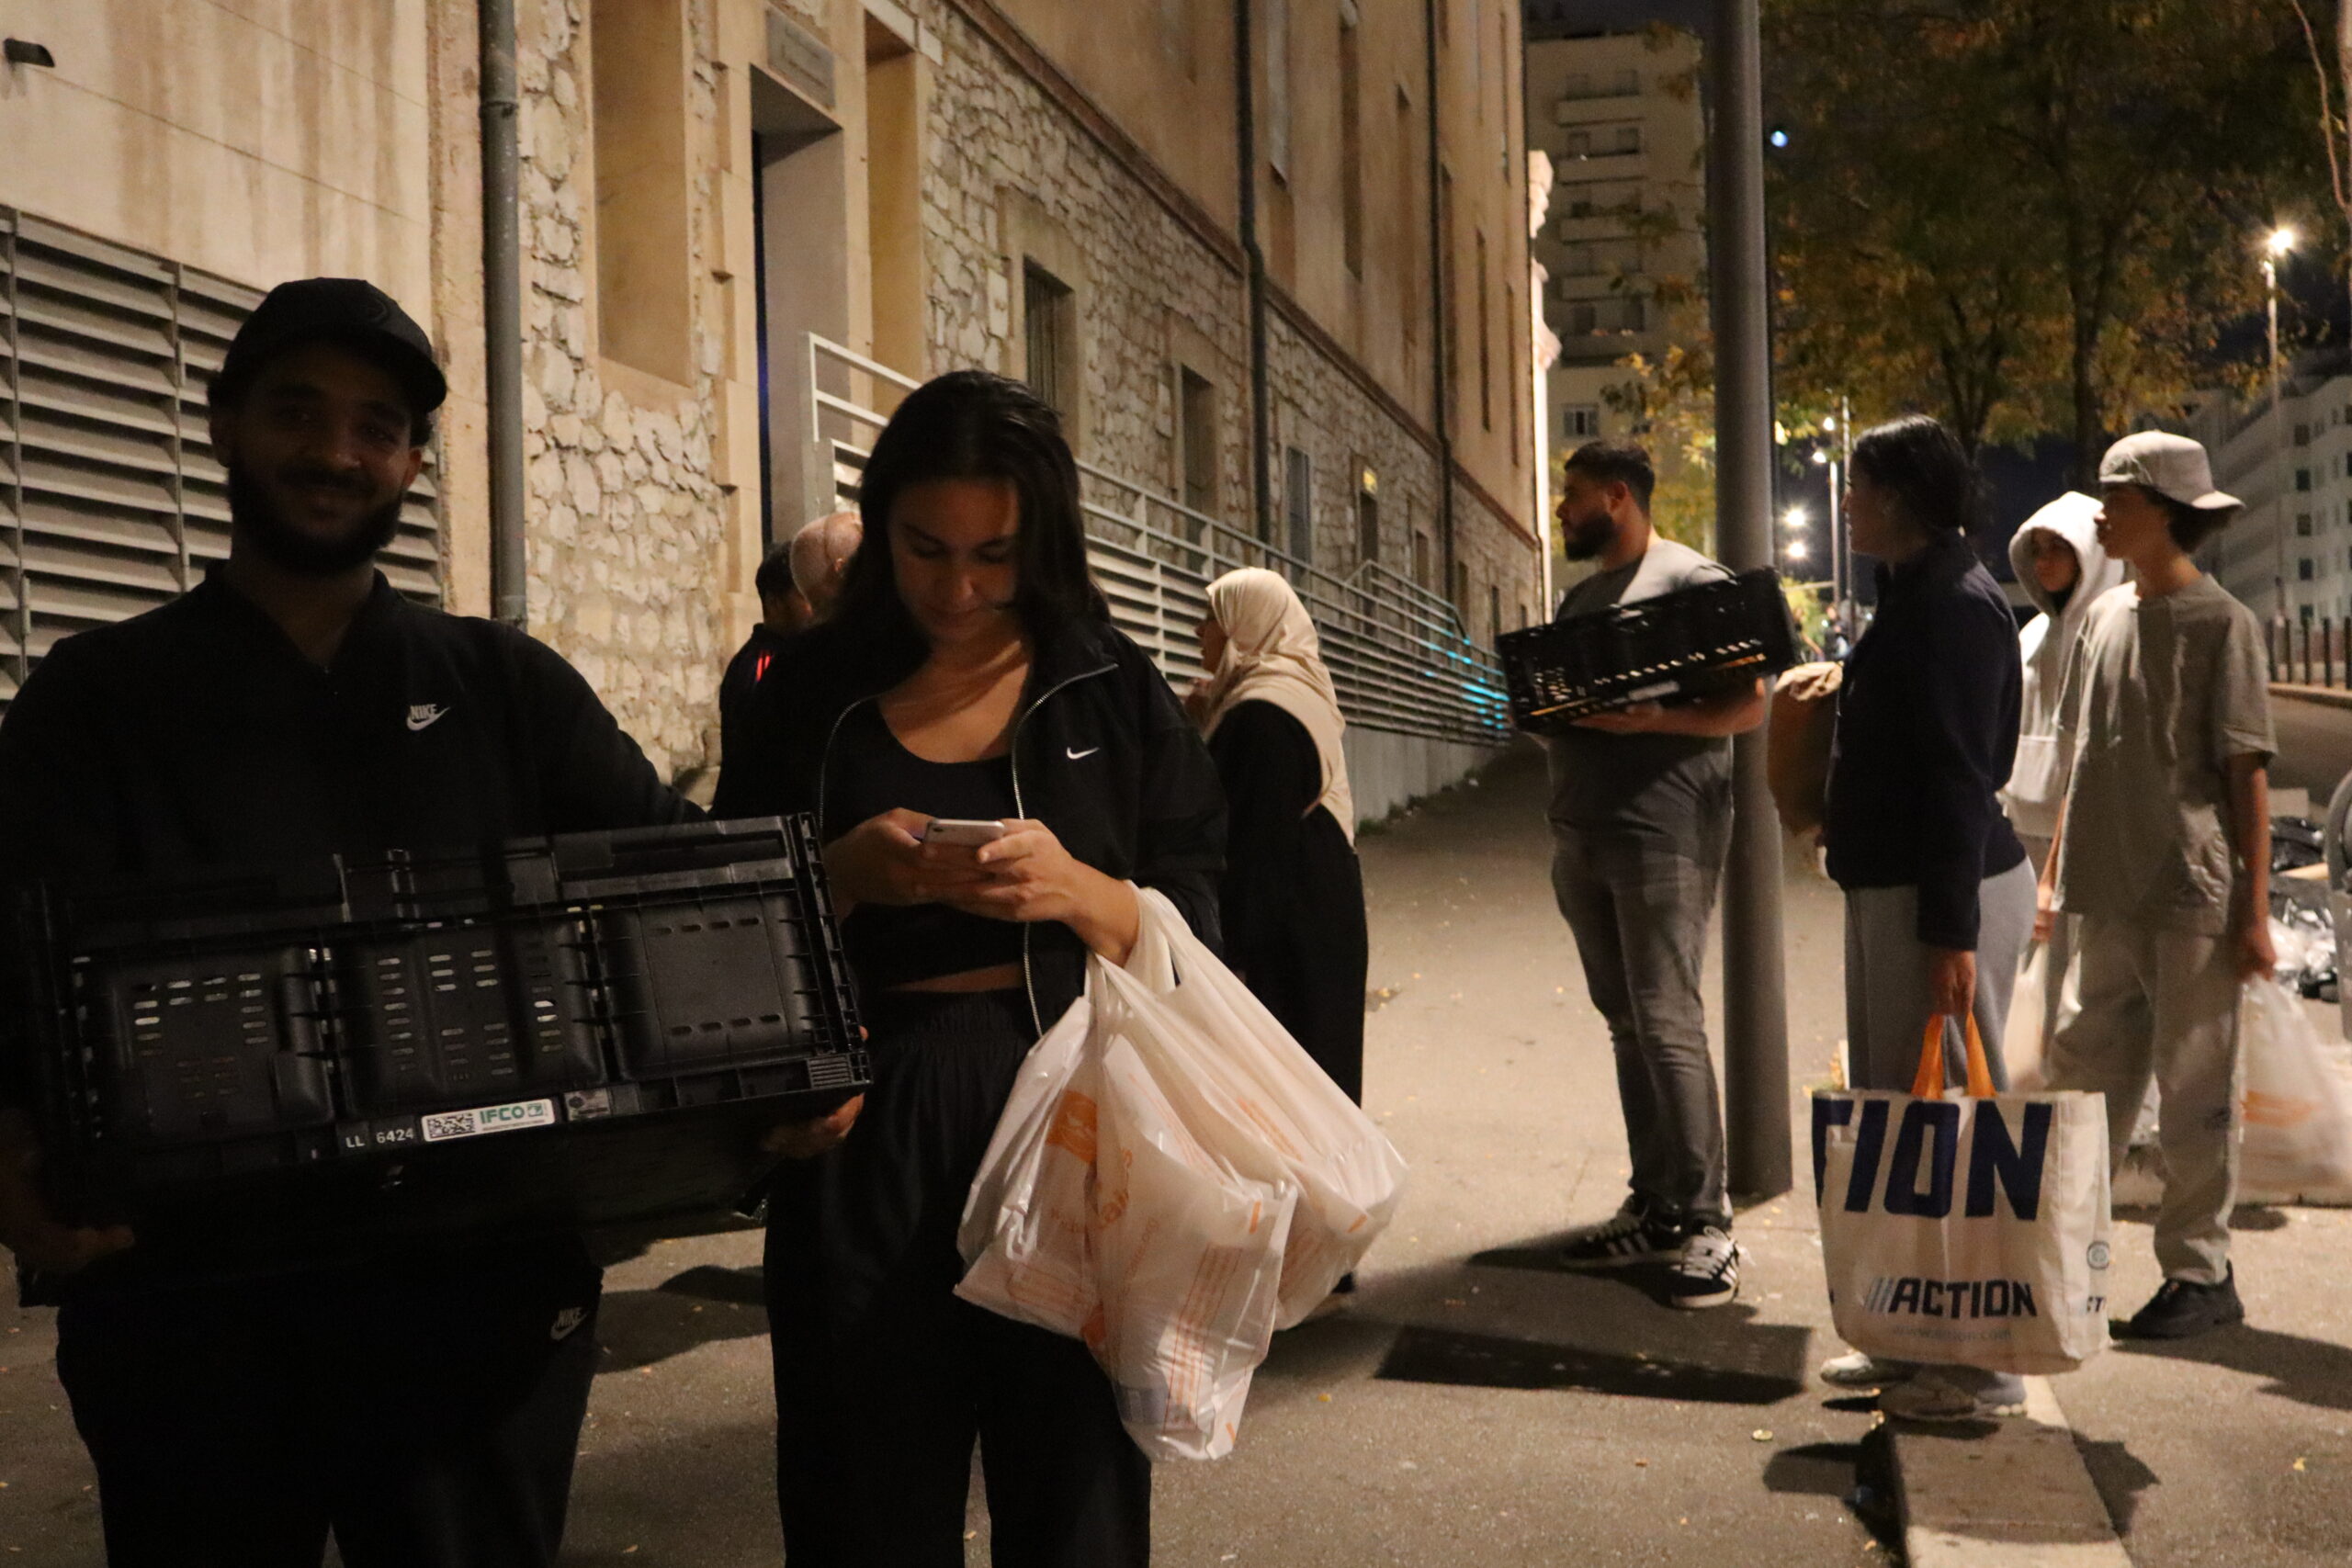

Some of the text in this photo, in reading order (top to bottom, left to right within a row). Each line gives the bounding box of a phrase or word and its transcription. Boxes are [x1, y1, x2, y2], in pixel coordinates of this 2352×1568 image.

[410, 704, 437, 719] NIKE
[480, 1105, 526, 1124] IFCO
[345, 1128, 414, 1148] LL 6424
[1888, 1277, 2037, 1320] ACTION
